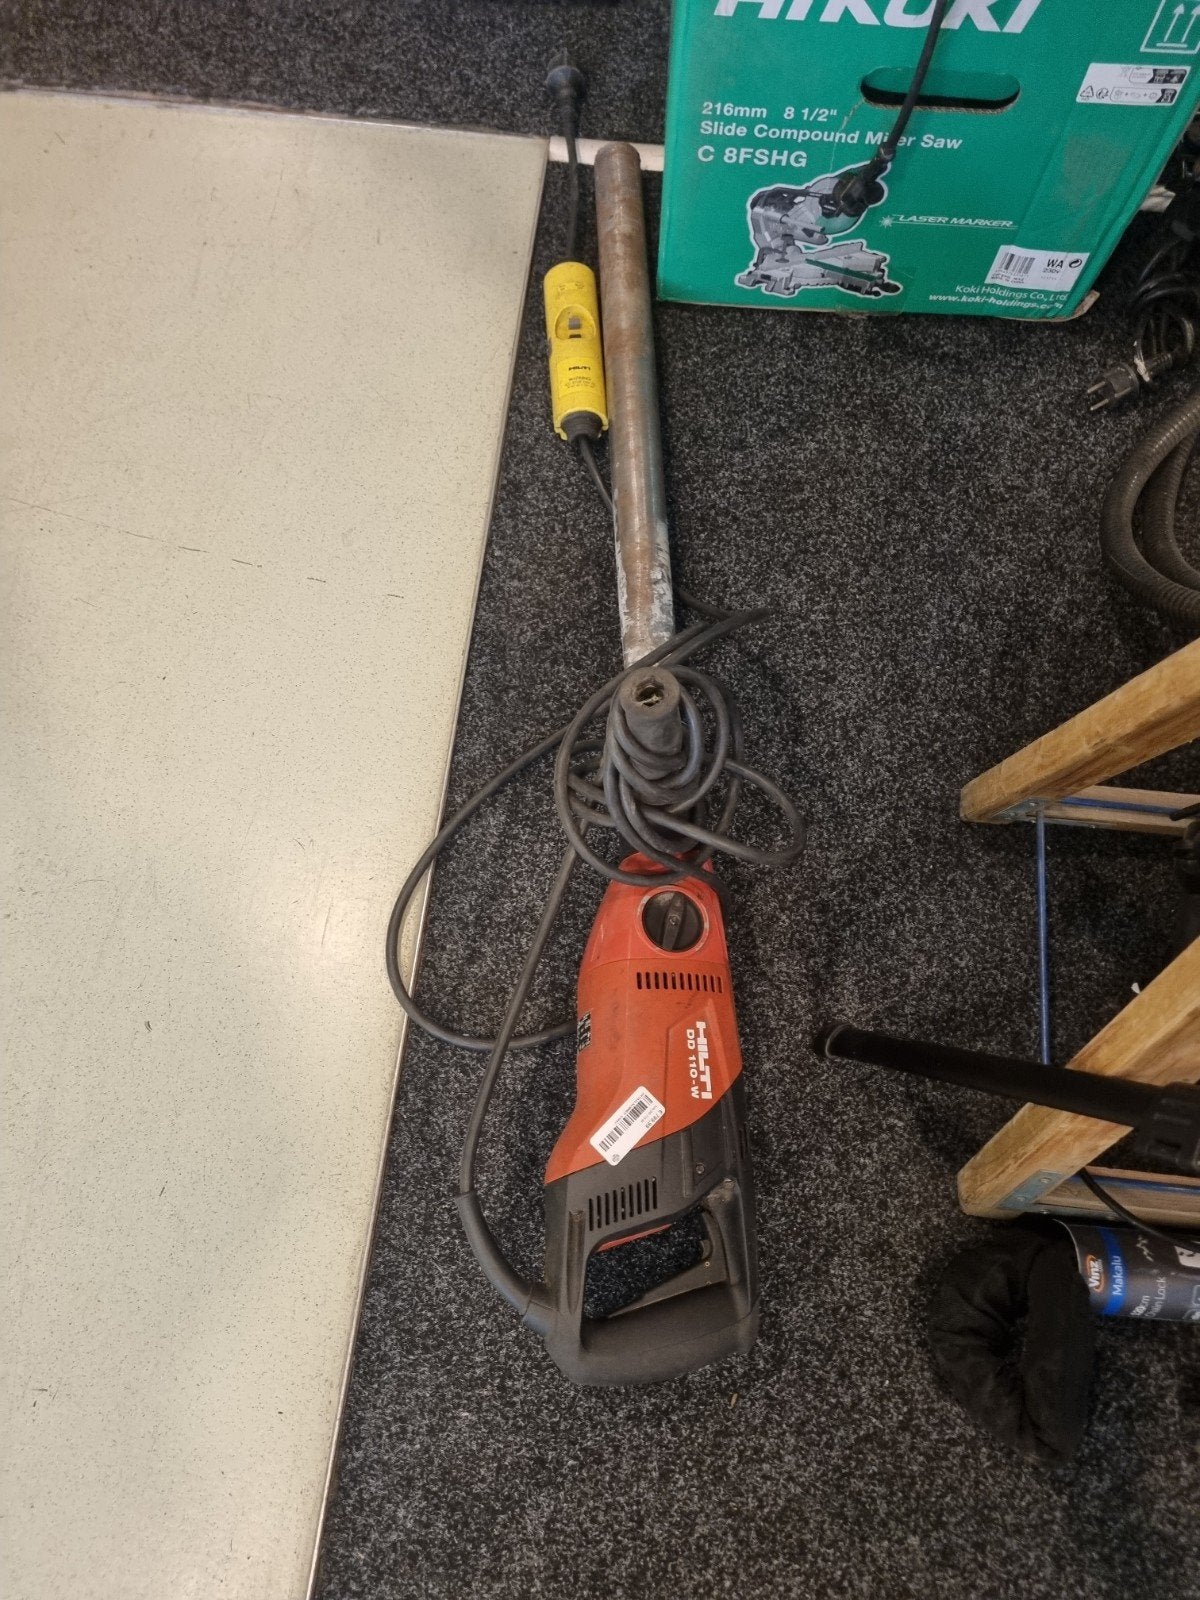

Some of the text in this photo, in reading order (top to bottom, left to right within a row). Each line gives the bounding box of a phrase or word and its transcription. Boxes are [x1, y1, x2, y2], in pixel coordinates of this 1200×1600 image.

[702, 102, 838, 122] 216mm 8 1/2"
[700, 120, 963, 150] Slide Compound Mier Saw
[697, 145, 807, 168] C 8FSHG
[898, 214, 1013, 227] LASER MARKER
[1047, 258, 1064, 269] WA
[955, 285, 980, 294] Koki
[980, 285, 1027, 299] Holdings
[686, 1029, 700, 1099] DD 110-W
[696, 1021, 713, 1099] HILTI
[1088, 1260, 1100, 1287] Vinz
[1111, 1255, 1123, 1296] Makalu
